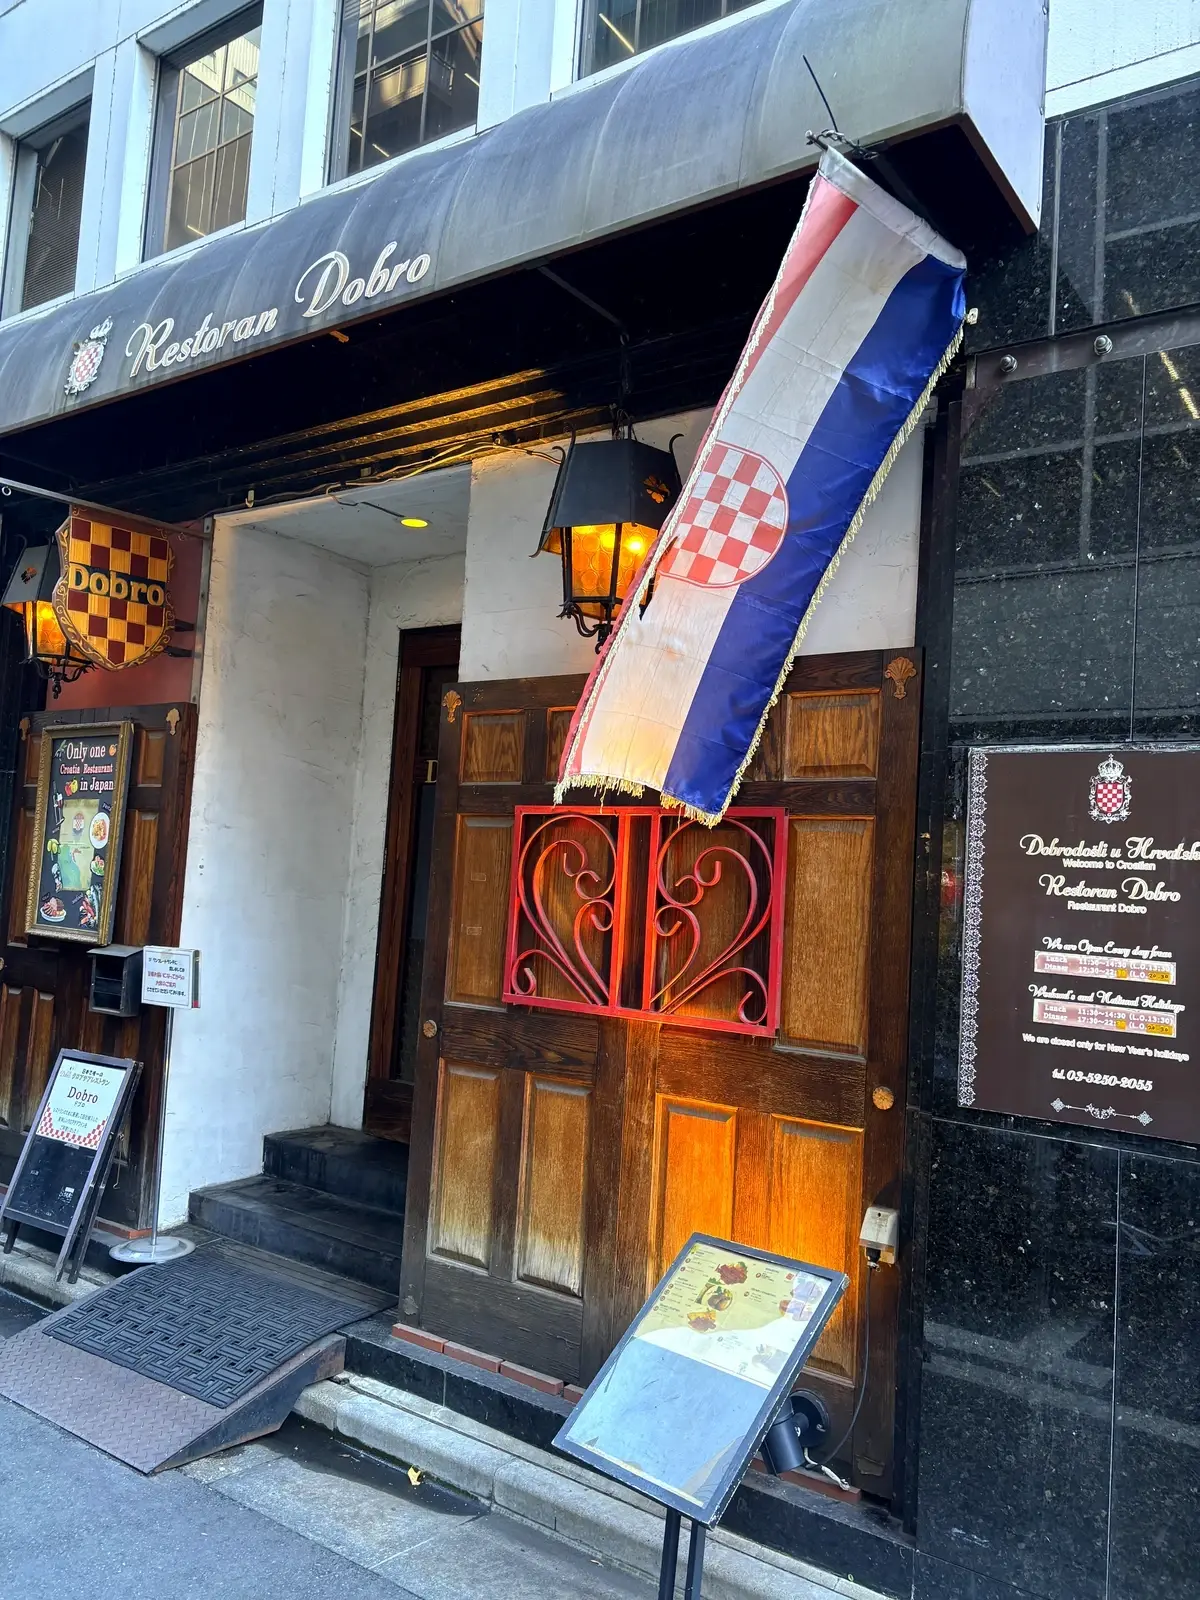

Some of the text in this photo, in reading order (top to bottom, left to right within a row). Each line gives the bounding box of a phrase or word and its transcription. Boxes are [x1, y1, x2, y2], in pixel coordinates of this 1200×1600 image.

[125, 240, 431, 379] Restoran Dobro
[68, 562, 164, 607] Dobro
[66, 741, 106, 763] Only one
[83, 763, 113, 774] Restaurant
[80, 776, 114, 794] in Japan
[1110, 847, 1122, 859] u
[1062, 857, 1157, 871] Welcome to Croatian
[1038, 873, 1181, 902] Restoran Dobro
[1067, 900, 1148, 914] Restaurant Dobro
[1042, 936, 1063, 951] We
[1078, 938, 1104, 955] Open
[1104, 940, 1130, 958] Every
[1131, 945, 1150, 959] day
[1044, 963, 1069, 973] Dinner
[1046, 955, 1069, 964] Lunch
[1044, 1005, 1067, 1014] Lunch
[1077, 992, 1095, 1003] and
[1096, 990, 1140, 1008] National
[1140, 994, 1186, 1015] Holidays
[1043, 1013, 1069, 1022] Dinner
[1022, 1033, 1190, 1062] We are closed only for New Year's holidays
[1066, 1069, 1153, 1092] 03-5250-2055
[67, 1086, 98, 1104] Dobro
